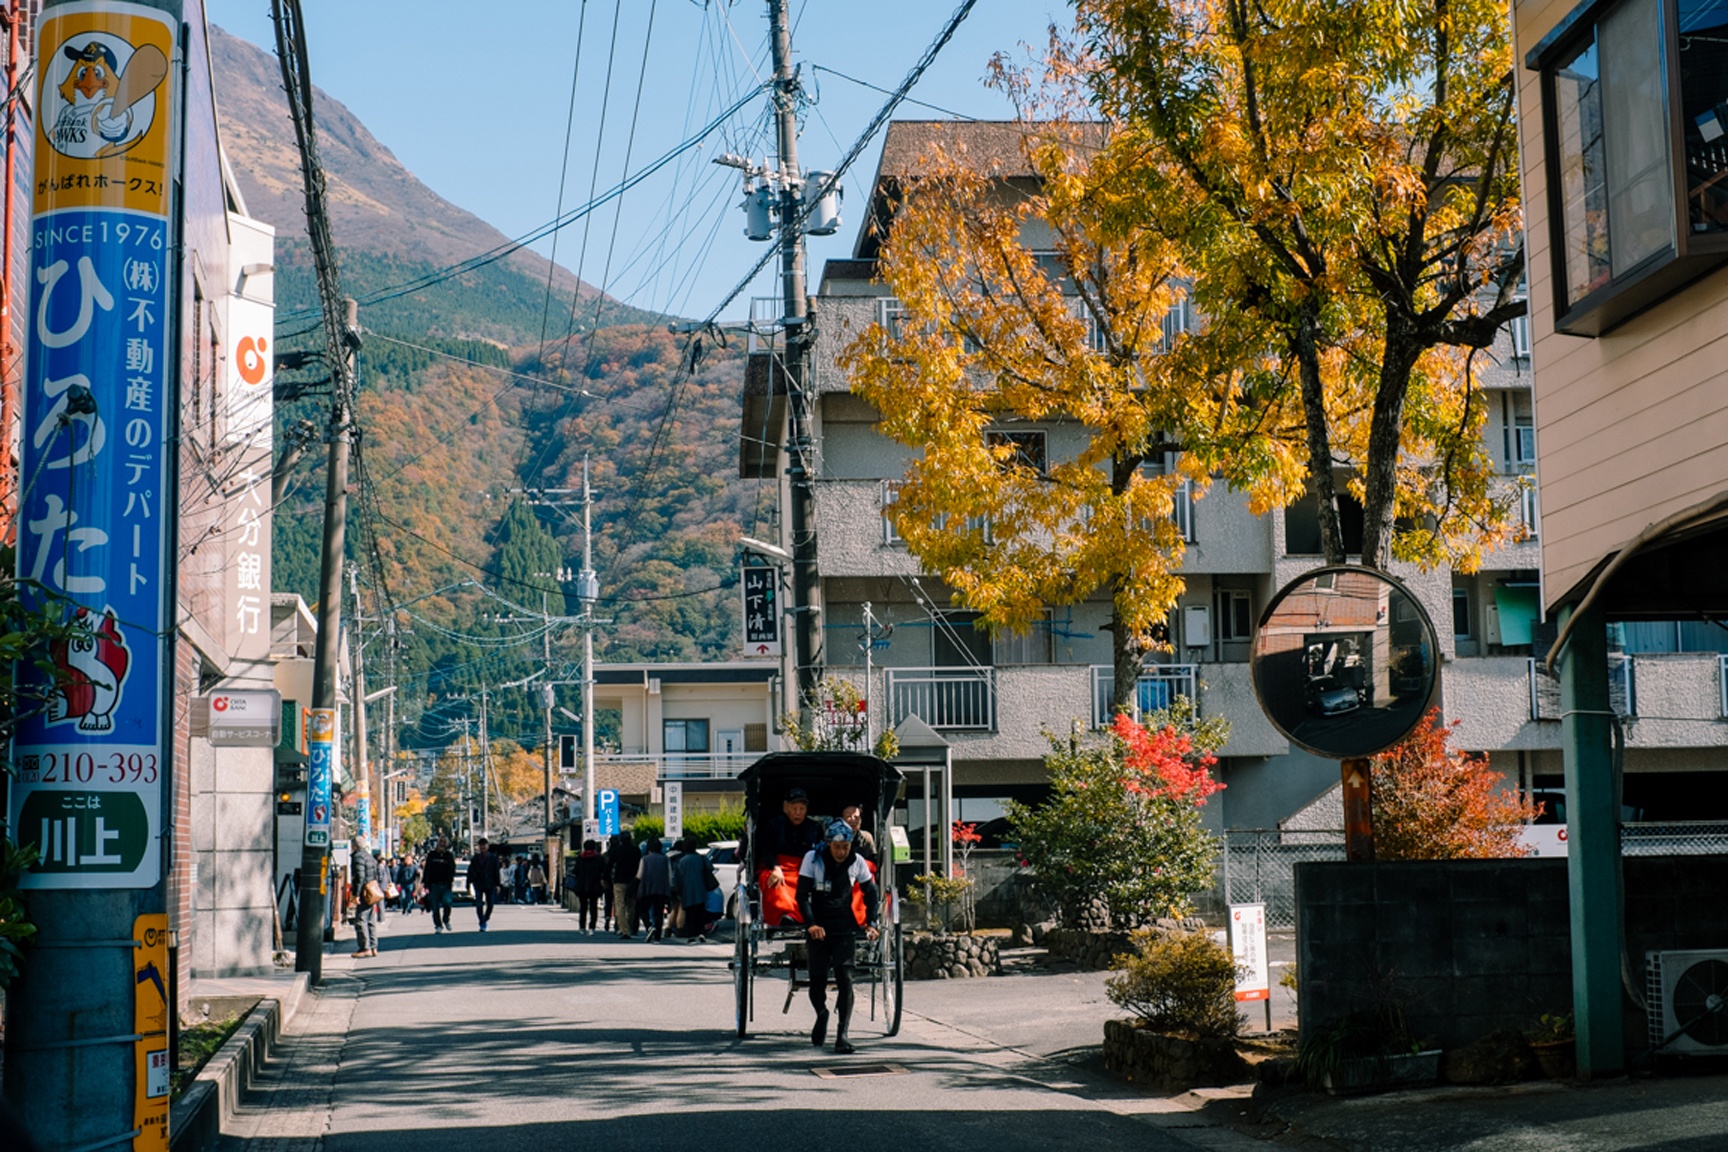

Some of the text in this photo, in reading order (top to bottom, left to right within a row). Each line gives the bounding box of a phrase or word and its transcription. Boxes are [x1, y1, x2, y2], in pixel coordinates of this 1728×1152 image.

[37, 173, 163, 196] がんばれホークス!
[35, 221, 163, 250] SINCE 1976
[29, 255, 115, 593] ひろた
[236, 467, 262, 635] 大分銀行
[747, 574, 766, 631] 山下清
[211, 729, 277, 739] 自動サービスコーナー
[42, 752, 158, 784] 210-393
[310, 748, 326, 803] ひろた
[61, 796, 102, 809] ここは
[600, 790, 615, 810] P
[38, 817, 122, 867] 川上
